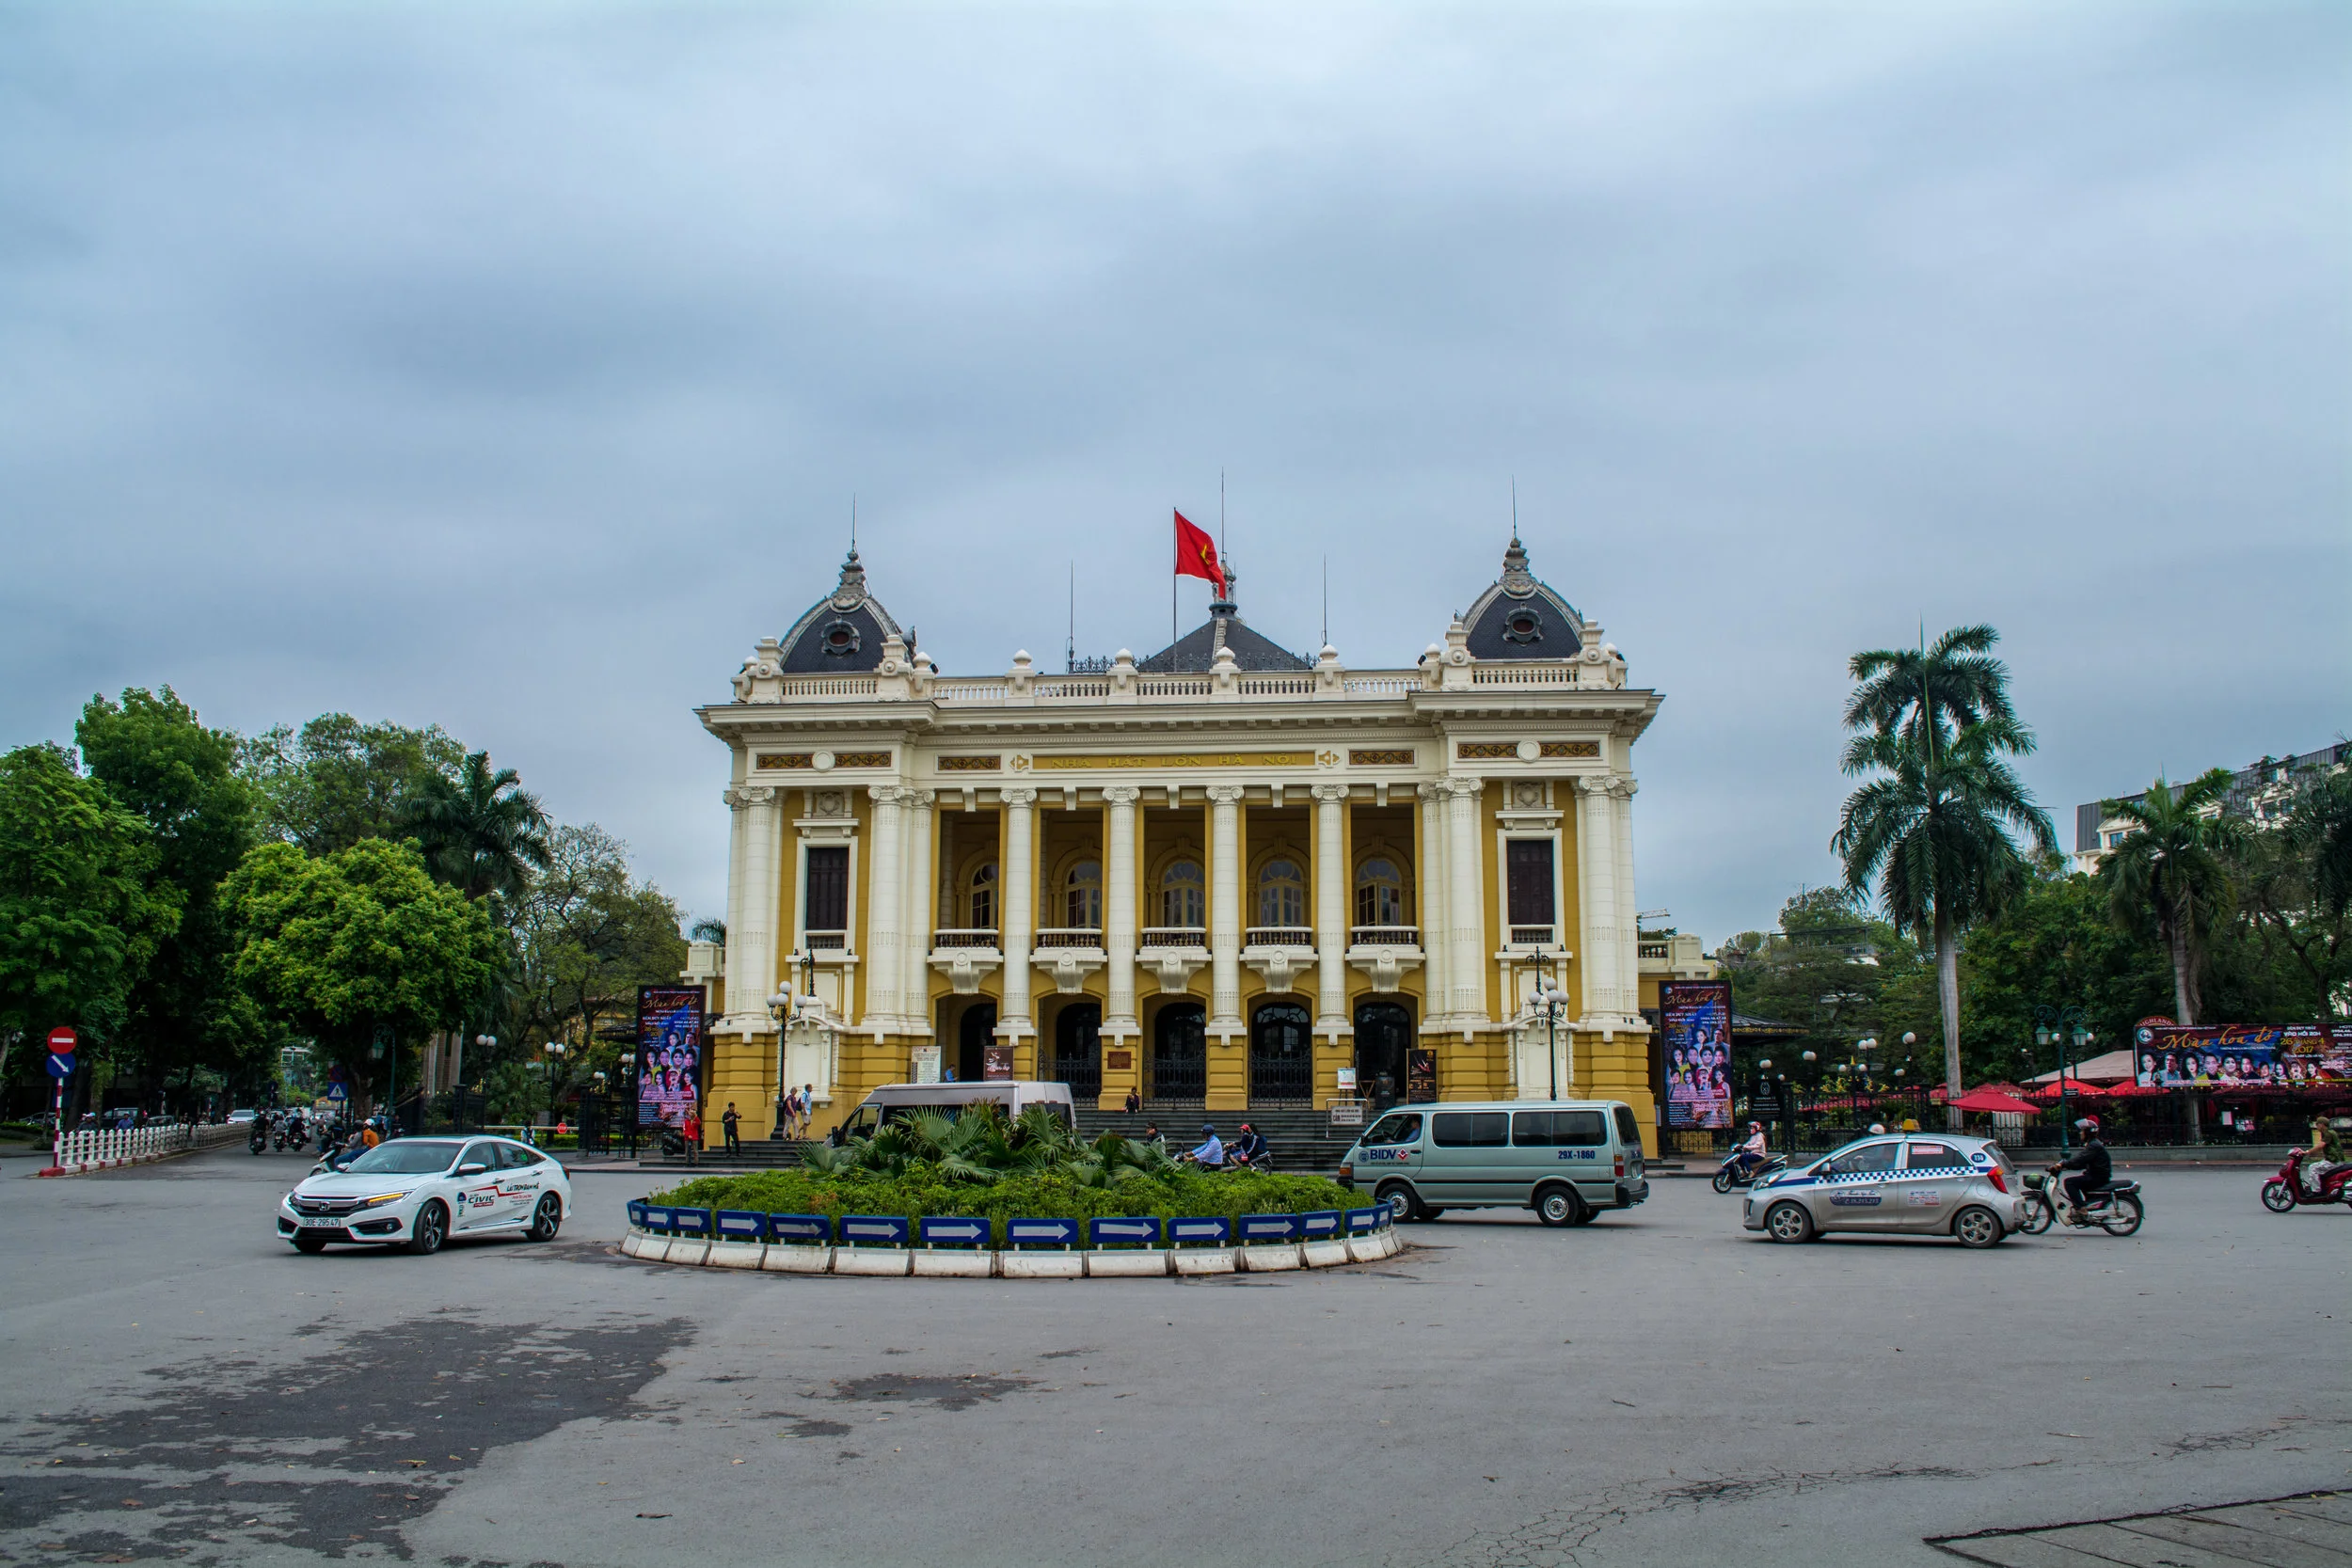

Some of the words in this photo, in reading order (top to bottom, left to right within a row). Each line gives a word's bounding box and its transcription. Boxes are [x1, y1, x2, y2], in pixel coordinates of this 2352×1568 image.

[1052, 755, 1091, 768] NHÀ
[1107, 755, 1146, 768] HÁT
[1218, 753, 1246, 766] HÀ
[1262, 753, 1296, 767] NỘI
[2218, 1026, 2248, 1045] hoa
[2254, 1026, 2275, 1043] đỏ
[2295, 1045, 2314, 1053] 2017
[1370, 1149, 1396, 1159] BIDV
[1558, 1150, 1596, 1159] 29X-1860
[469, 1196, 495, 1204] CIVIC
